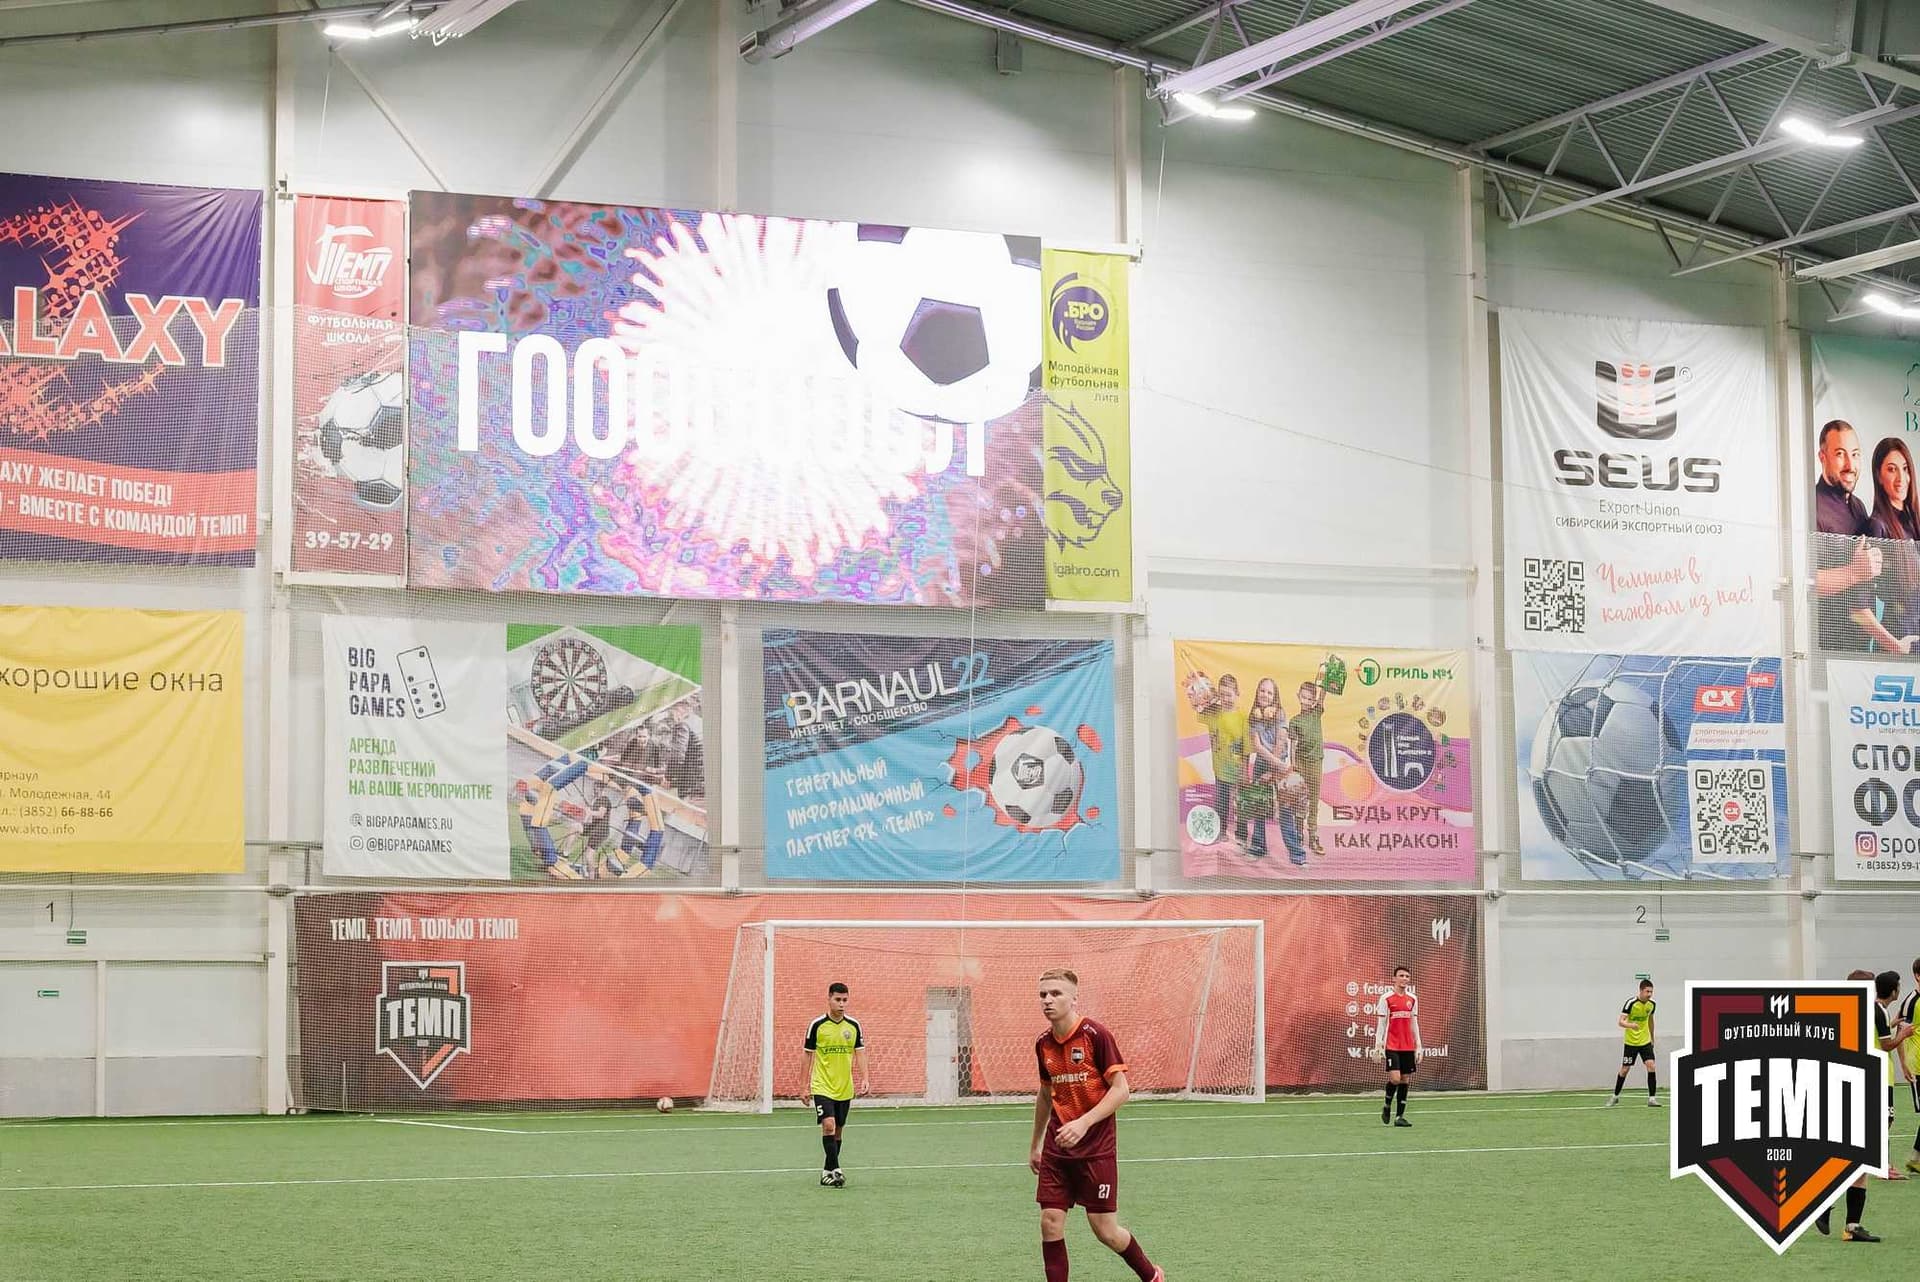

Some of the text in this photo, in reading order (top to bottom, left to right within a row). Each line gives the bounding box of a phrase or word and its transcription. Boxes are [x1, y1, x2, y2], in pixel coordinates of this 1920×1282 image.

[0, 285, 245, 368] LAXY
[307, 314, 394, 331] ФУТБОЛЬНАЯ
[326, 332, 371, 344] ШКОЛА
[1048, 360, 1119, 376] Молодёжная
[1049, 375, 1119, 390] футбольная
[1554, 449, 1722, 493] SEUS
[38, 466, 107, 498] ЖЕЛАЕТ
[111, 478, 173, 508] ПОБЕД!
[20, 494, 84, 525] ВМЕСТЕ
[89, 507, 100, 528] С
[104, 508, 196, 538] КОМАНДОЙ
[199, 513, 248, 537] ТЕМП!
[1555, 517, 1723, 535] СИБИРСКИЙ ЭКСПОРТНЫЙ СОЮЗ
[305, 530, 393, 552] 39-57-29
[1597, 556, 1703, 593] Чемпион в
[1601, 575, 1753, 622] каждом из нас!
[348, 646, 376, 669] BIG
[0, 667, 224, 694] хорошие окна
[349, 671, 391, 694] PAPA
[1386, 667, 1429, 679] ГРИЛЬ
[350, 695, 406, 718] GAMES
[1850, 705, 1920, 729] SportL
[349, 737, 396, 756] АРЕНДА
[349, 758, 436, 777] РАЗВЛЕЧЕНИЙ
[786, 757, 888, 797] ГЕНЕРАЛЬНЫЙ
[349, 779, 493, 800] НА ВАШЕ МЕРОПРИЯТИЕ
[20, 806, 58, 818] (3852)
[61, 806, 114, 818] 66-88-66
[787, 777, 925, 829] ИНФОРМАЦИОННЫЙ
[366, 815, 453, 830] BIGPAPAGAMES.RU
[1332, 805, 1446, 824] БУДЬ КРУТ,
[786, 809, 935, 859] ПАРТНЕР ФК «ТЕМП»
[1334, 832, 1458, 851] КАК ДРАКОН!
[367, 837, 453, 853] @BIGPAPAGAMES
[1866, 860, 1900, 871] 8(3852)
[46, 901, 54, 923] 1
[1635, 905, 1647, 924] 2
[330, 917, 518, 942] ТЕМП, ТЕМП, ТОЛЬКО ТЕМП!
[386, 997, 461, 1040] ТЕМП
[816, 1105, 824, 1117] 5
[1098, 1184, 1111, 1199] 27
